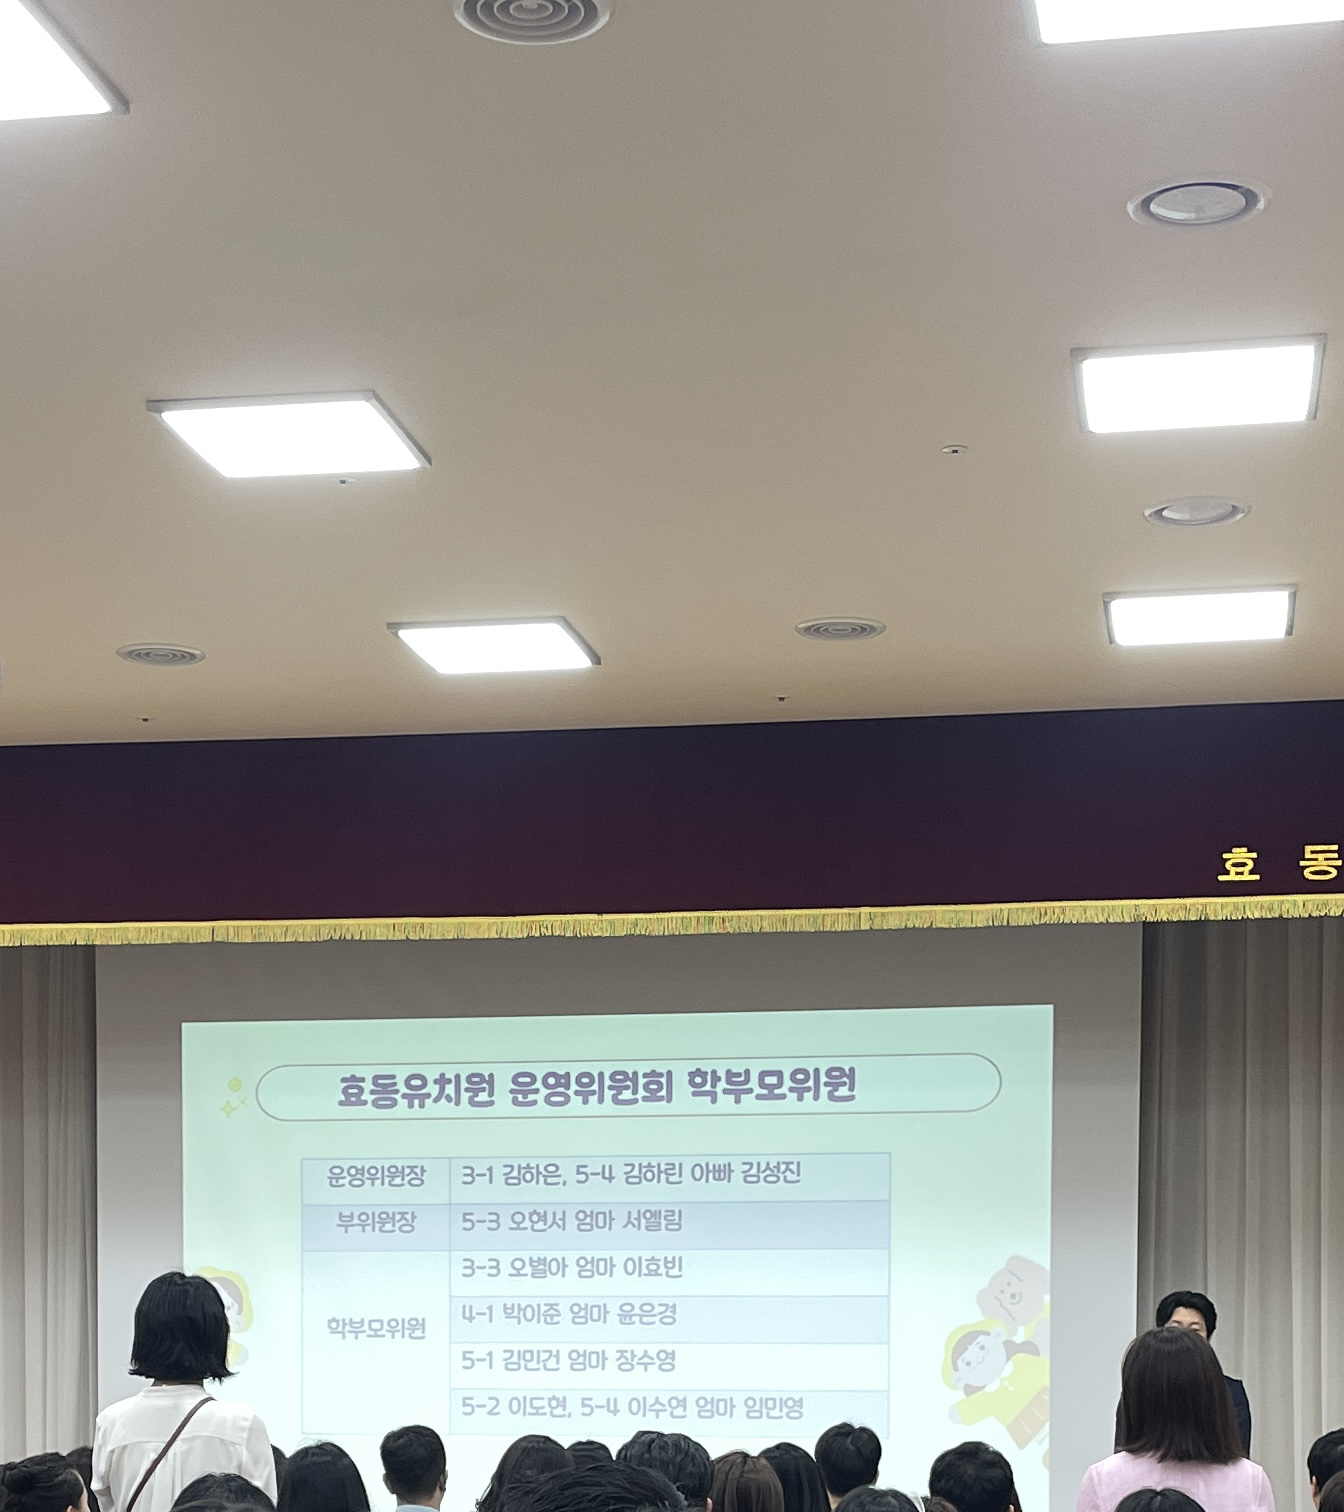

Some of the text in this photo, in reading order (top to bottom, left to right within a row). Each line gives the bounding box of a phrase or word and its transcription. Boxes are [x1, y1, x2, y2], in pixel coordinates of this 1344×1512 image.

[338, 1066, 857, 1110] 효동유치원 운영위원회 학부모위원
[327, 1165, 427, 1188] 운영위원장
[462, 1161, 802, 1187] 3-1 김하은, 5-4 김하린 아빠 김성진
[336, 1211, 418, 1234] 부위원장
[462, 1212, 501, 1232] 5-3
[508, 1209, 566, 1232] 오현서
[575, 1209, 615, 1232] 엄마
[462, 1256, 683, 1279] 3-3 오별아 엄마 이효빈
[462, 1302, 678, 1326] 4-1 박이준 엄마 윤은경
[327, 1317, 426, 1340] 학부모위원
[462, 1349, 676, 1373] 5-1 김민건 엄마 장수영
[462, 1395, 804, 1420] 5-2 이도현, 5-4 이수연 엄마 임민영
